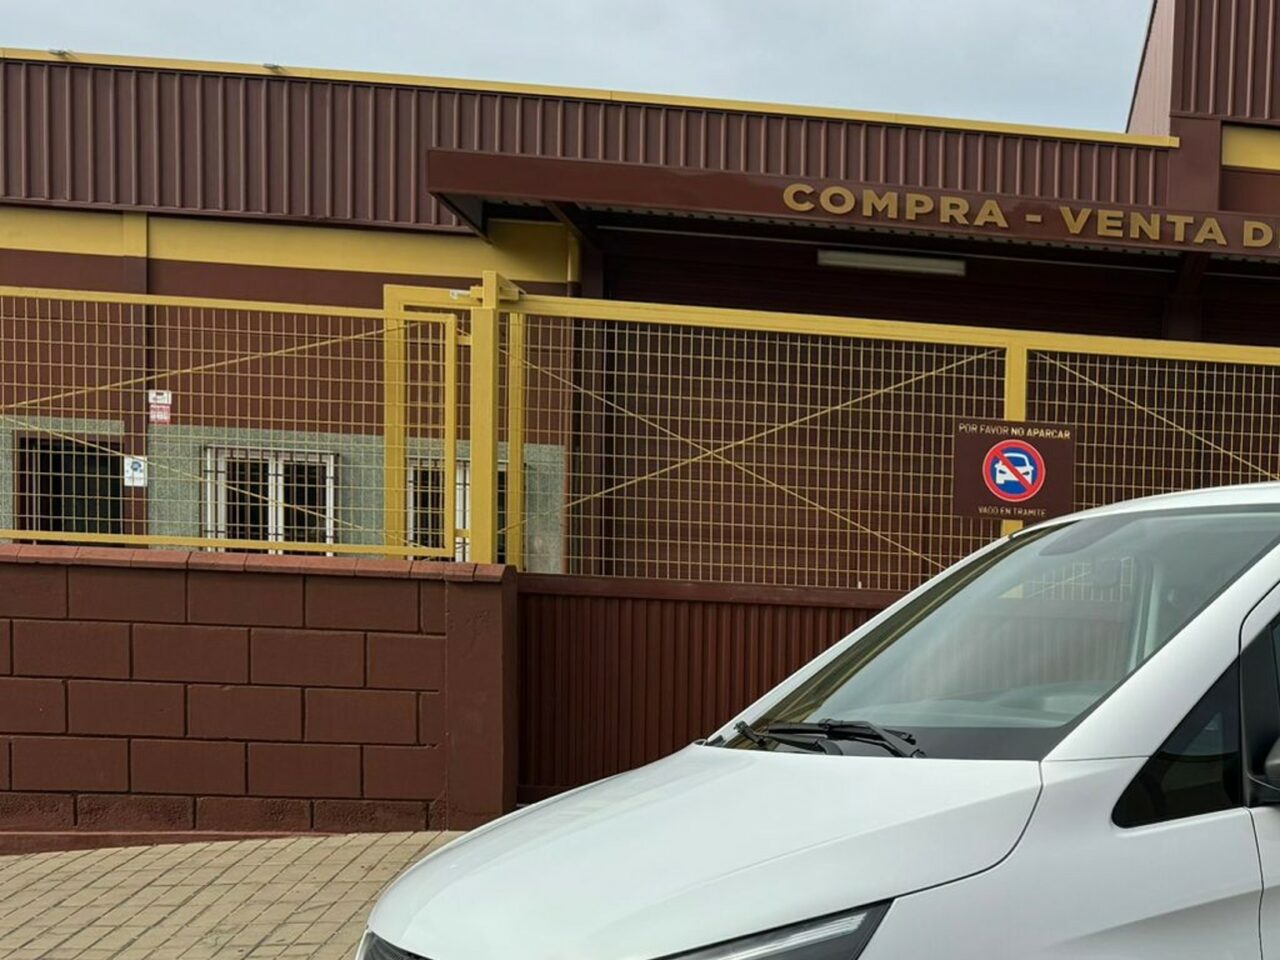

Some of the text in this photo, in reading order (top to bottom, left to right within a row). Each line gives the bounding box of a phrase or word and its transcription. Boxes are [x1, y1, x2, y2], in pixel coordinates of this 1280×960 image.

[782, 183, 1009, 228] COMPRA
[1059, 206, 1227, 247] VENTA
[959, 422, 1071, 439] POR FAVOR NO APARCAR
[1000, 507, 1012, 516] EN
